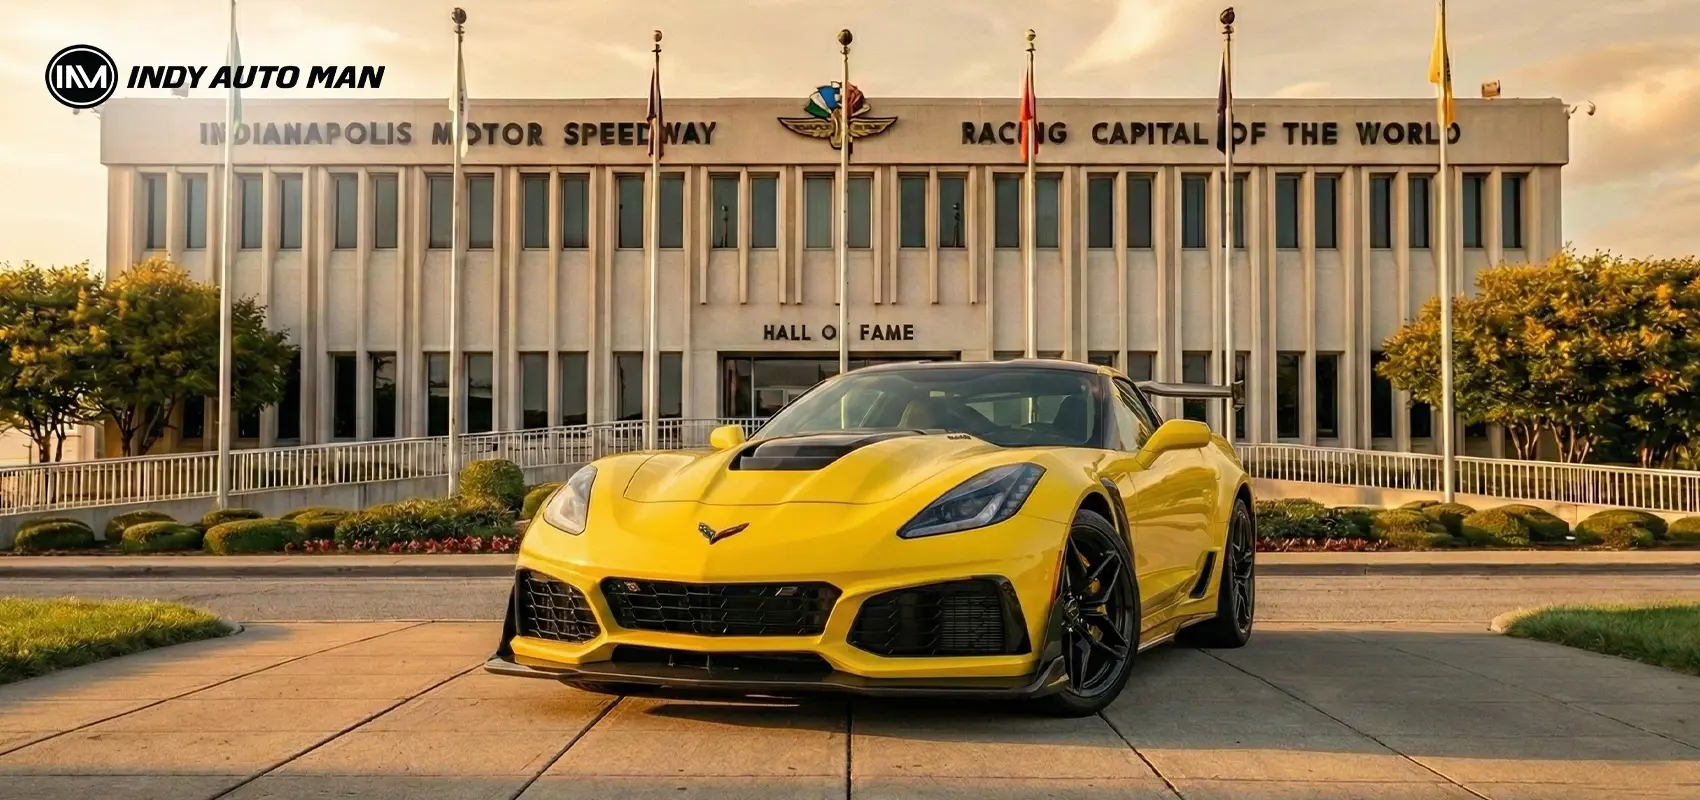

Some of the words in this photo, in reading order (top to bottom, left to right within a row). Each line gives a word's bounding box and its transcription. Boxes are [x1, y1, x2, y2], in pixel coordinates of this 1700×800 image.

[200, 122, 413, 146] INDIANAPOLIS
[431, 121, 544, 146] MOTOR
[563, 121, 717, 146] SPEEDWAY
[1091, 121, 1209, 145] CAPITAL
[1231, 121, 1267, 146] OF
[1282, 121, 1338, 146] THE
[1355, 121, 1461, 146] WORLD
[763, 324, 811, 341] HALL
[859, 324, 914, 341] FAME
